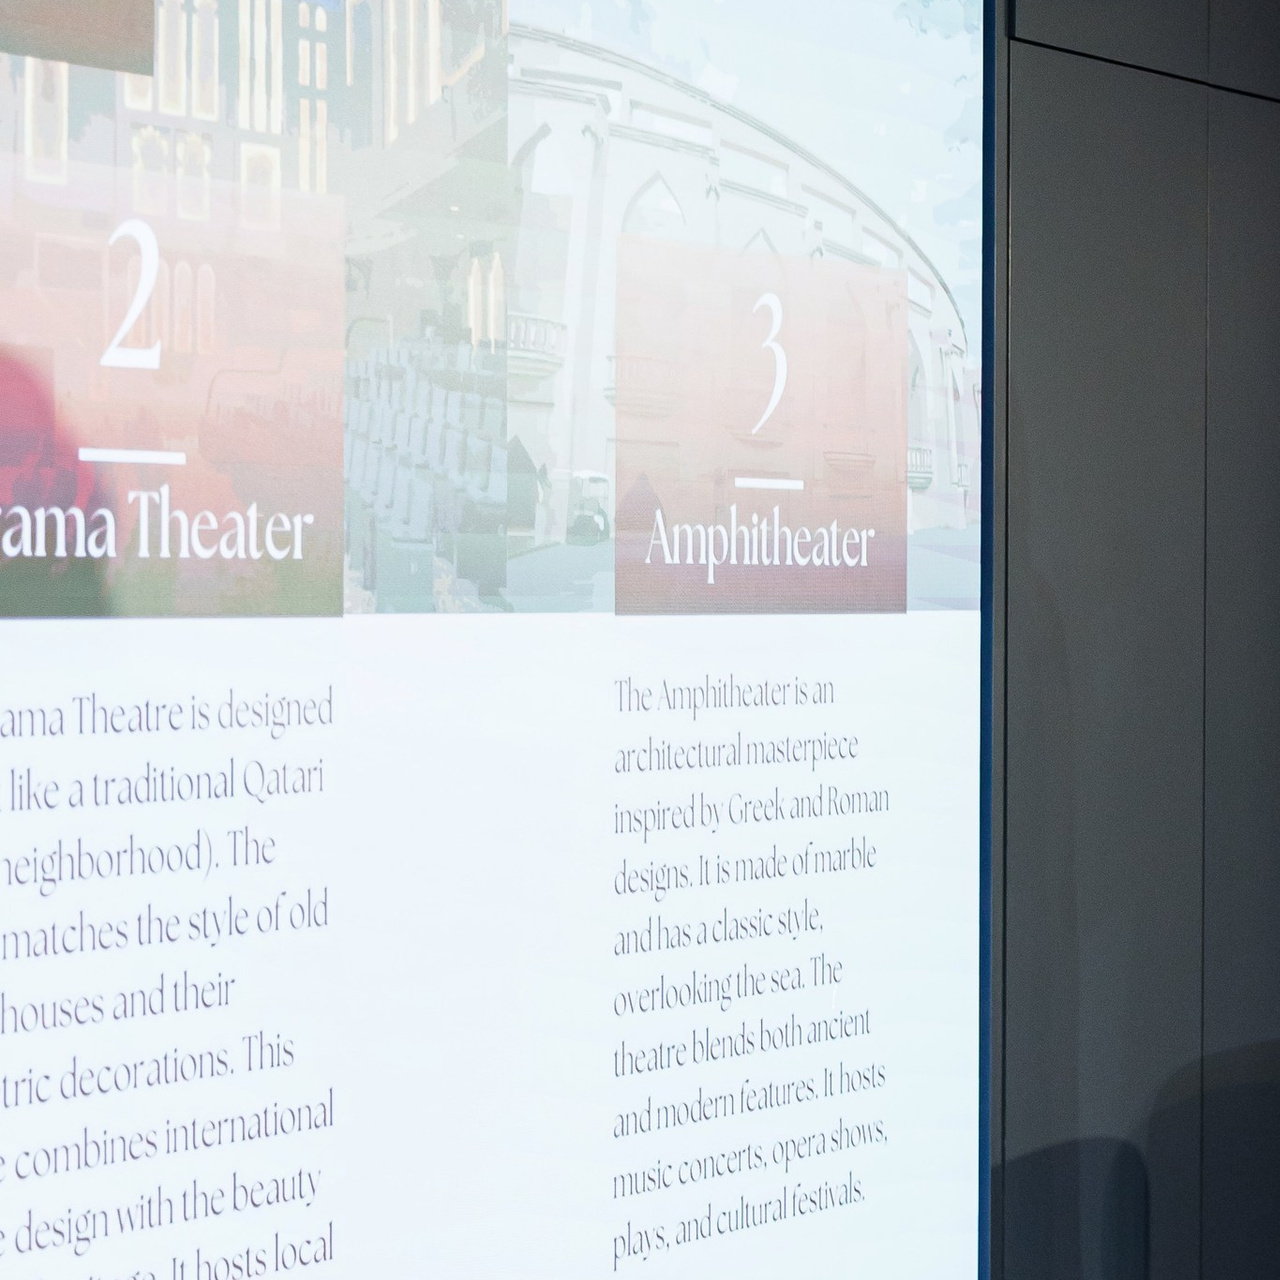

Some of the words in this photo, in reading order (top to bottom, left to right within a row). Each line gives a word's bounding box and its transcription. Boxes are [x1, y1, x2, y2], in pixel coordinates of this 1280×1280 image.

[99, 219, 161, 370] 2
[752, 292, 788, 435] 3
[0, 505, 117, 559] ama
[128, 483, 315, 560] Theater
[645, 503, 876, 584] Amphitheater
[0, 707, 65, 739] ama
[71, 691, 184, 735] Theatre
[191, 695, 210, 731] is
[217, 684, 333, 741] designed
[614, 676, 653, 713] The
[657, 672, 791, 722] Amphitheater
[794, 675, 809, 706] is
[812, 681, 835, 705] an
[10, 767, 60, 812] like
[68, 779, 85, 809] a
[92, 756, 235, 808] traditional
[242, 758, 324, 805] Qatari
[614, 730, 742, 774] architectural
[746, 731, 859, 773] masterpiece
[226, 825, 276, 867] The
[614, 792, 695, 845] inspired
[700, 791, 724, 834] by
[728, 786, 786, 825] Greek
[789, 782, 824, 820] and
[827, 785, 890, 816] Roman
[614, 857, 693, 904] designs.
[699, 854, 711, 887] It
[716, 854, 731, 885] is
[735, 843, 788, 883] made
[791, 840, 814, 877] of
[814, 835, 877, 874] marble
[1, 909, 129, 961] matches
[136, 902, 181, 947] the
[188, 894, 249, 948] style
[256, 890, 287, 934] of
[289, 886, 328, 931] old
[613, 915, 653, 957] and
[657, 914, 692, 951] has
[696, 921, 708, 946] a
[711, 906, 774, 944] classic
[777, 897, 824, 941] style,
[0, 991, 105, 1035] houses
[112, 971, 165, 1021] and
[172, 969, 236, 1013] their
[613, 969, 733, 1017] overlooking
[736, 962, 766, 999] the
[770, 967, 806, 994] sea.
[809, 952, 843, 987] The
[1, 1067, 51, 1110] tric
[59, 1047, 235, 1100] decorations.
[241, 1029, 295, 1072] This
[613, 1040, 687, 1079] theatre
[692, 1021, 756, 1065] blends
[759, 1012, 803, 1053] both
[806, 1008, 871, 1045] ancient
[14, 1126, 158, 1180] combines
[165, 1086, 334, 1155] international
[613, 1095, 652, 1140] and
[656, 1086, 735, 1131] modern
[740, 1077, 819, 1115] features.
[824, 1067, 835, 1098] It
[839, 1060, 886, 1095] hosts
[613, 1159, 674, 1200] music
[677, 1143, 768, 1186] concerts,
[772, 1132, 826, 1174] opera
[830, 1116, 888, 1153] shows,
[14, 1207, 109, 1258] design
[116, 1184, 174, 1234] with
[181, 1178, 225, 1223] the
[232, 1168, 322, 1213] beauty
[274, 1220, 334, 1273] local
[613, 1219, 670, 1273] plays,
[675, 1202, 712, 1246] and
[716, 1185, 787, 1236] cultural
[792, 1170, 866, 1218] festivals.
